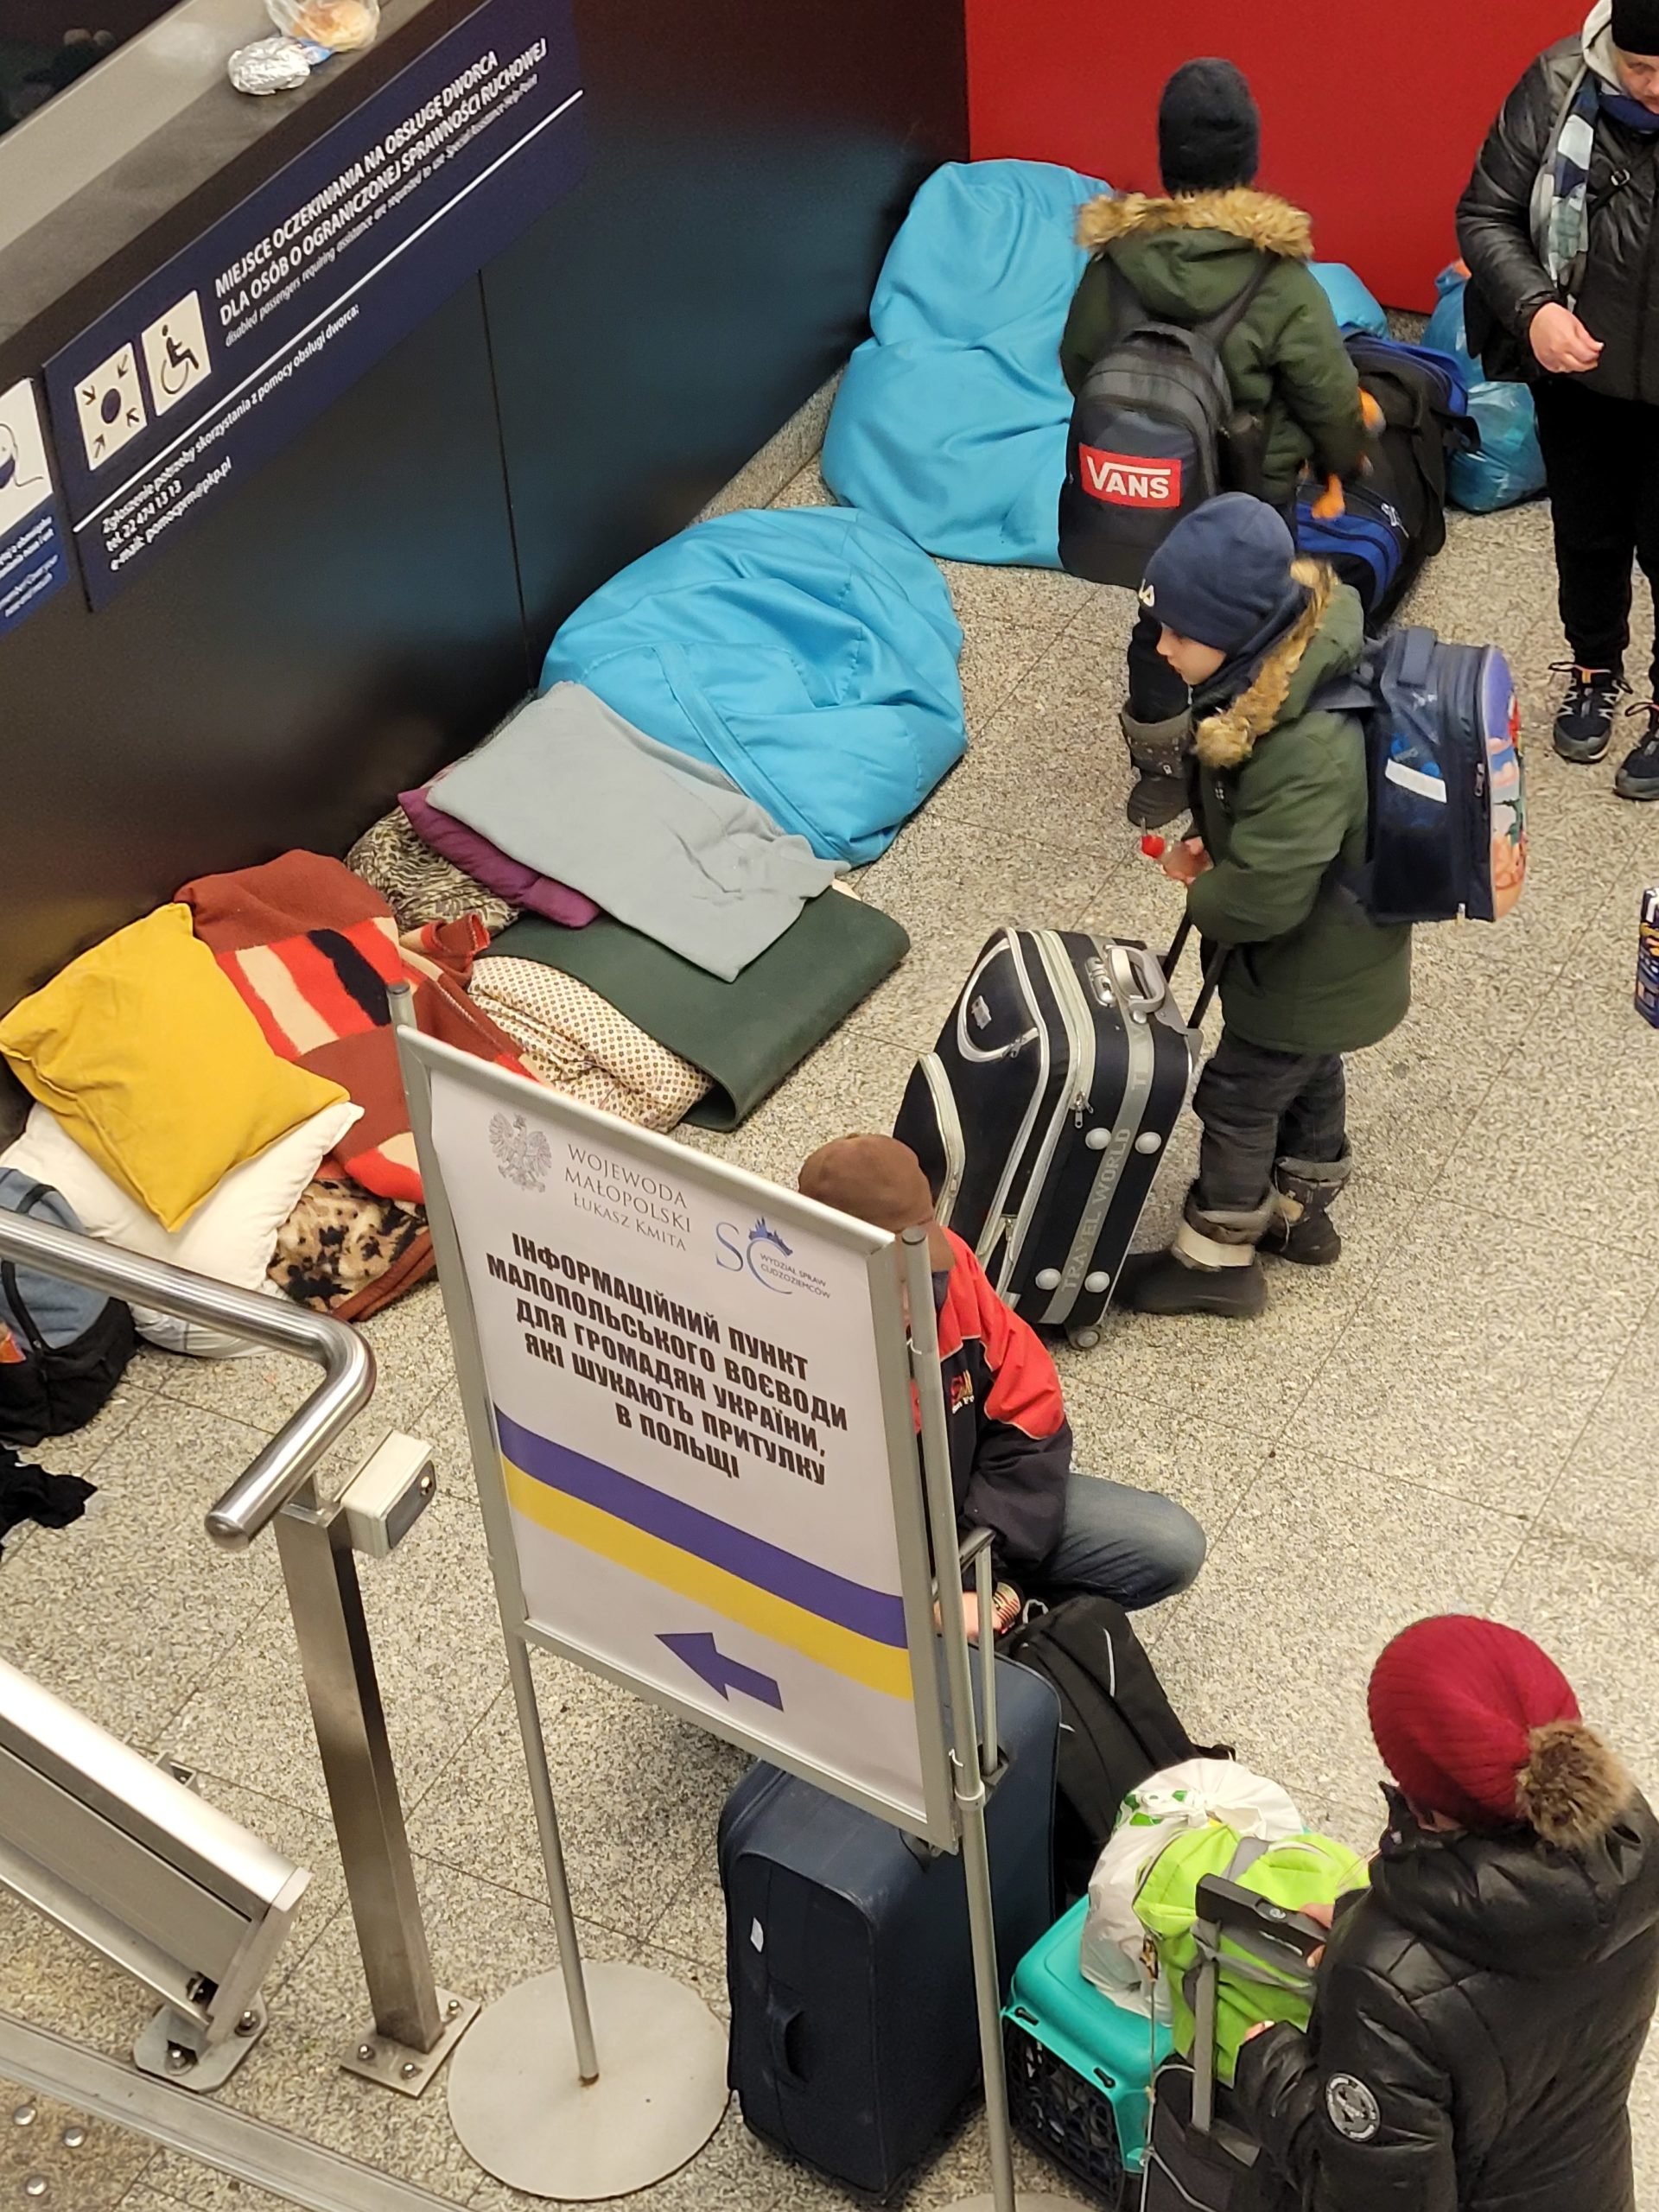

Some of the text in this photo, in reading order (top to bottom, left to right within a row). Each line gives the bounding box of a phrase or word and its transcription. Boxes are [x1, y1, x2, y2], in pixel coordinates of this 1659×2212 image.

[216, 51, 498, 297] MIEJSCE OCZEKIWANIA NA OBSŁUGĘ DWORCA
[220, 38, 546, 325] DLA OSÓB O OGRANICZONEJ SPRAWNOŚCI RUCHOWEJ
[260, 277, 300, 321] passengers
[196, 399, 251, 453] skorzystania
[251, 393, 257, 404] z
[257, 362, 292, 401] pomocy
[294, 331, 325, 366] obsługi
[326, 304, 359, 339] dworca:
[156, 492, 168, 508] 13
[168, 480, 181, 497] 13
[1087, 456, 1171, 499] VANS
[566, 1167, 690, 1232] MAŁOPOLSKI
[568, 1144, 687, 1209] WOJEWODA
[1062, 1128, 1130, 1292] TRAVEL WORLD
[512, 1233, 808, 1381] ІНФОРМАЦІЙНИЙ ПУНКТ
[760, 1254, 826, 1287] WYDZIAŁ SPRAW
[761, 1264, 830, 1298] CUDZOZIEMCÓW
[486, 1253, 847, 1431] МАЛОПОЛЬСЬКОГО ВОЄВОДИ
[517, 1298, 824, 1457] ДЛЯ ГРОМАДЯН УКРАЇНИ,
[524, 1333, 824, 1485] ЯКІ ШУКАЮТЬ ПРИТУЛКУ
[615, 1402, 740, 1478] В ПОЛЬЩІ
